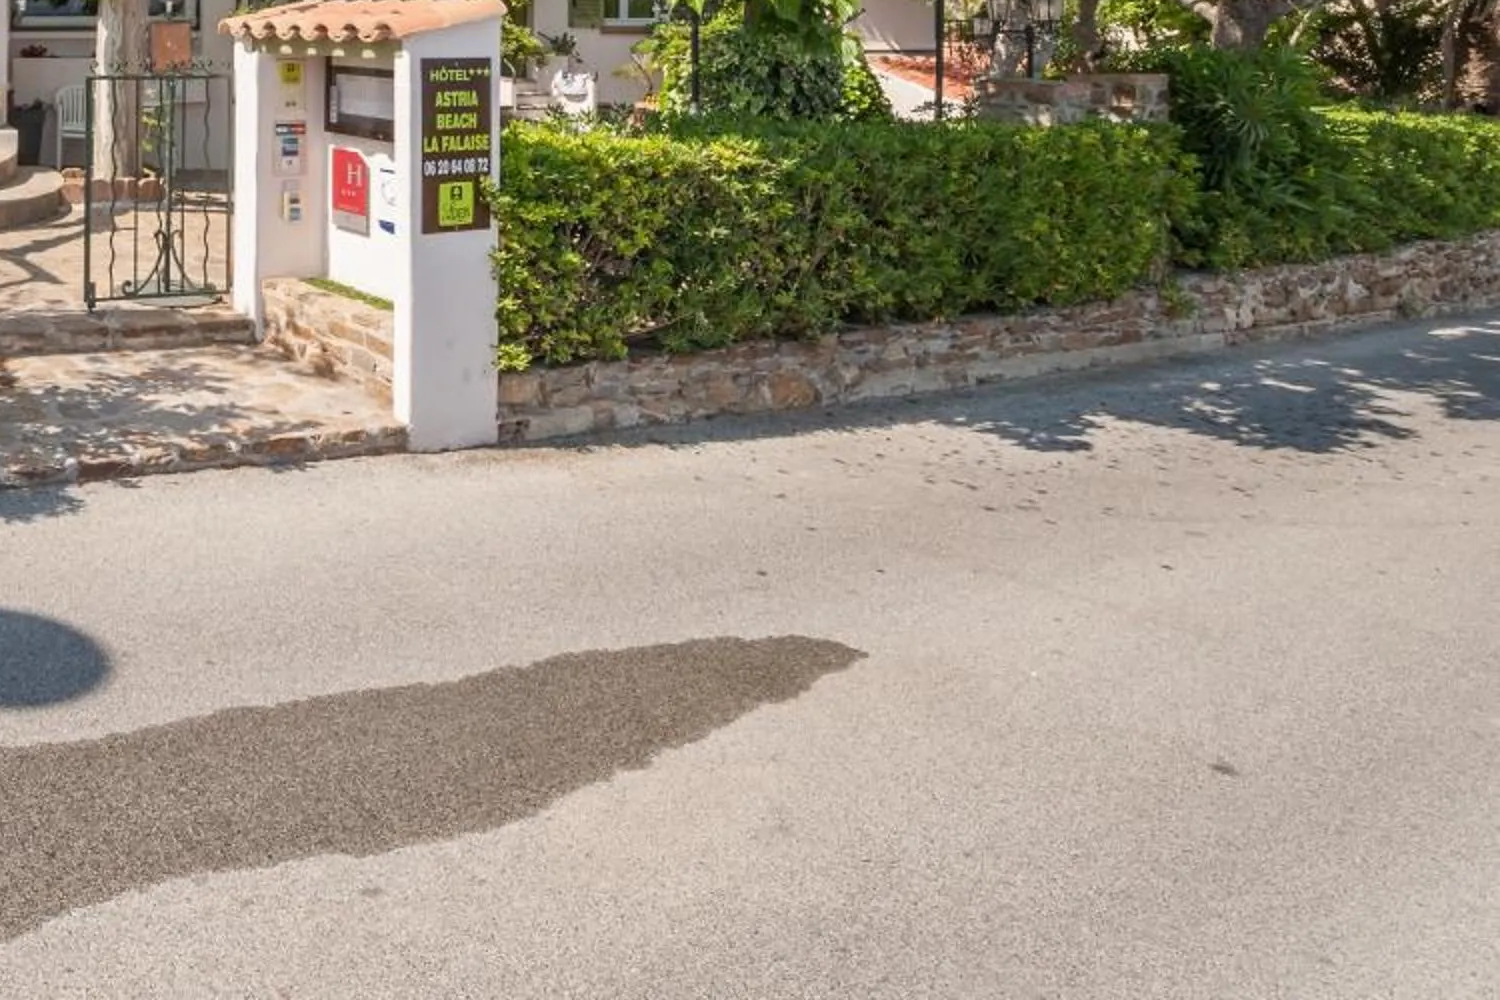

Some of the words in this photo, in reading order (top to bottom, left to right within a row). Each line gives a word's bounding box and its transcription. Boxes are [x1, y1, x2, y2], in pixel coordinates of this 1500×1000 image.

[435, 90, 479, 107] ASTRIA
[436, 112, 477, 130] BEACH
[423, 135, 440, 153] LA
[441, 133, 489, 152] FALAISE
[346, 163, 363, 187] H
